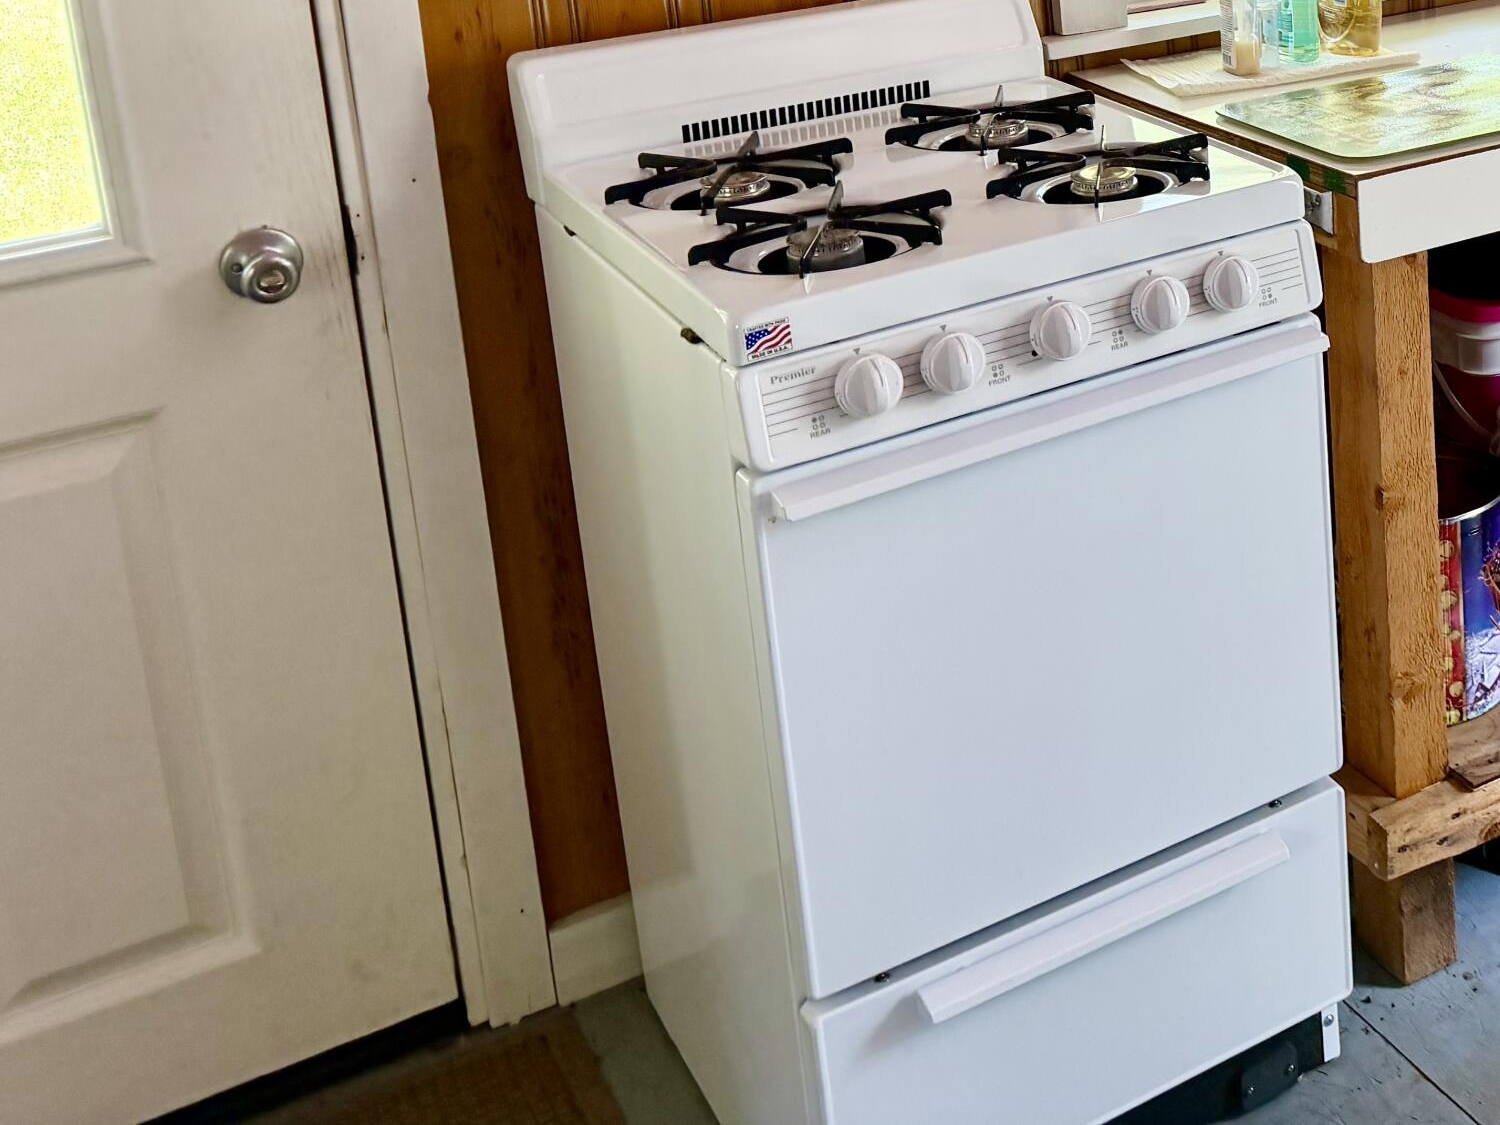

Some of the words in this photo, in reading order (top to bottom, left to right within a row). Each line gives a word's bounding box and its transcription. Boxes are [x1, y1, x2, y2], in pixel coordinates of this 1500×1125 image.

[1258, 298, 1278, 308] FRONT
[1111, 341, 1128, 351] REAR
[769, 365, 816, 386] Premier
[988, 374, 1011, 387] FRONT
[809, 427, 831, 440] REAR
